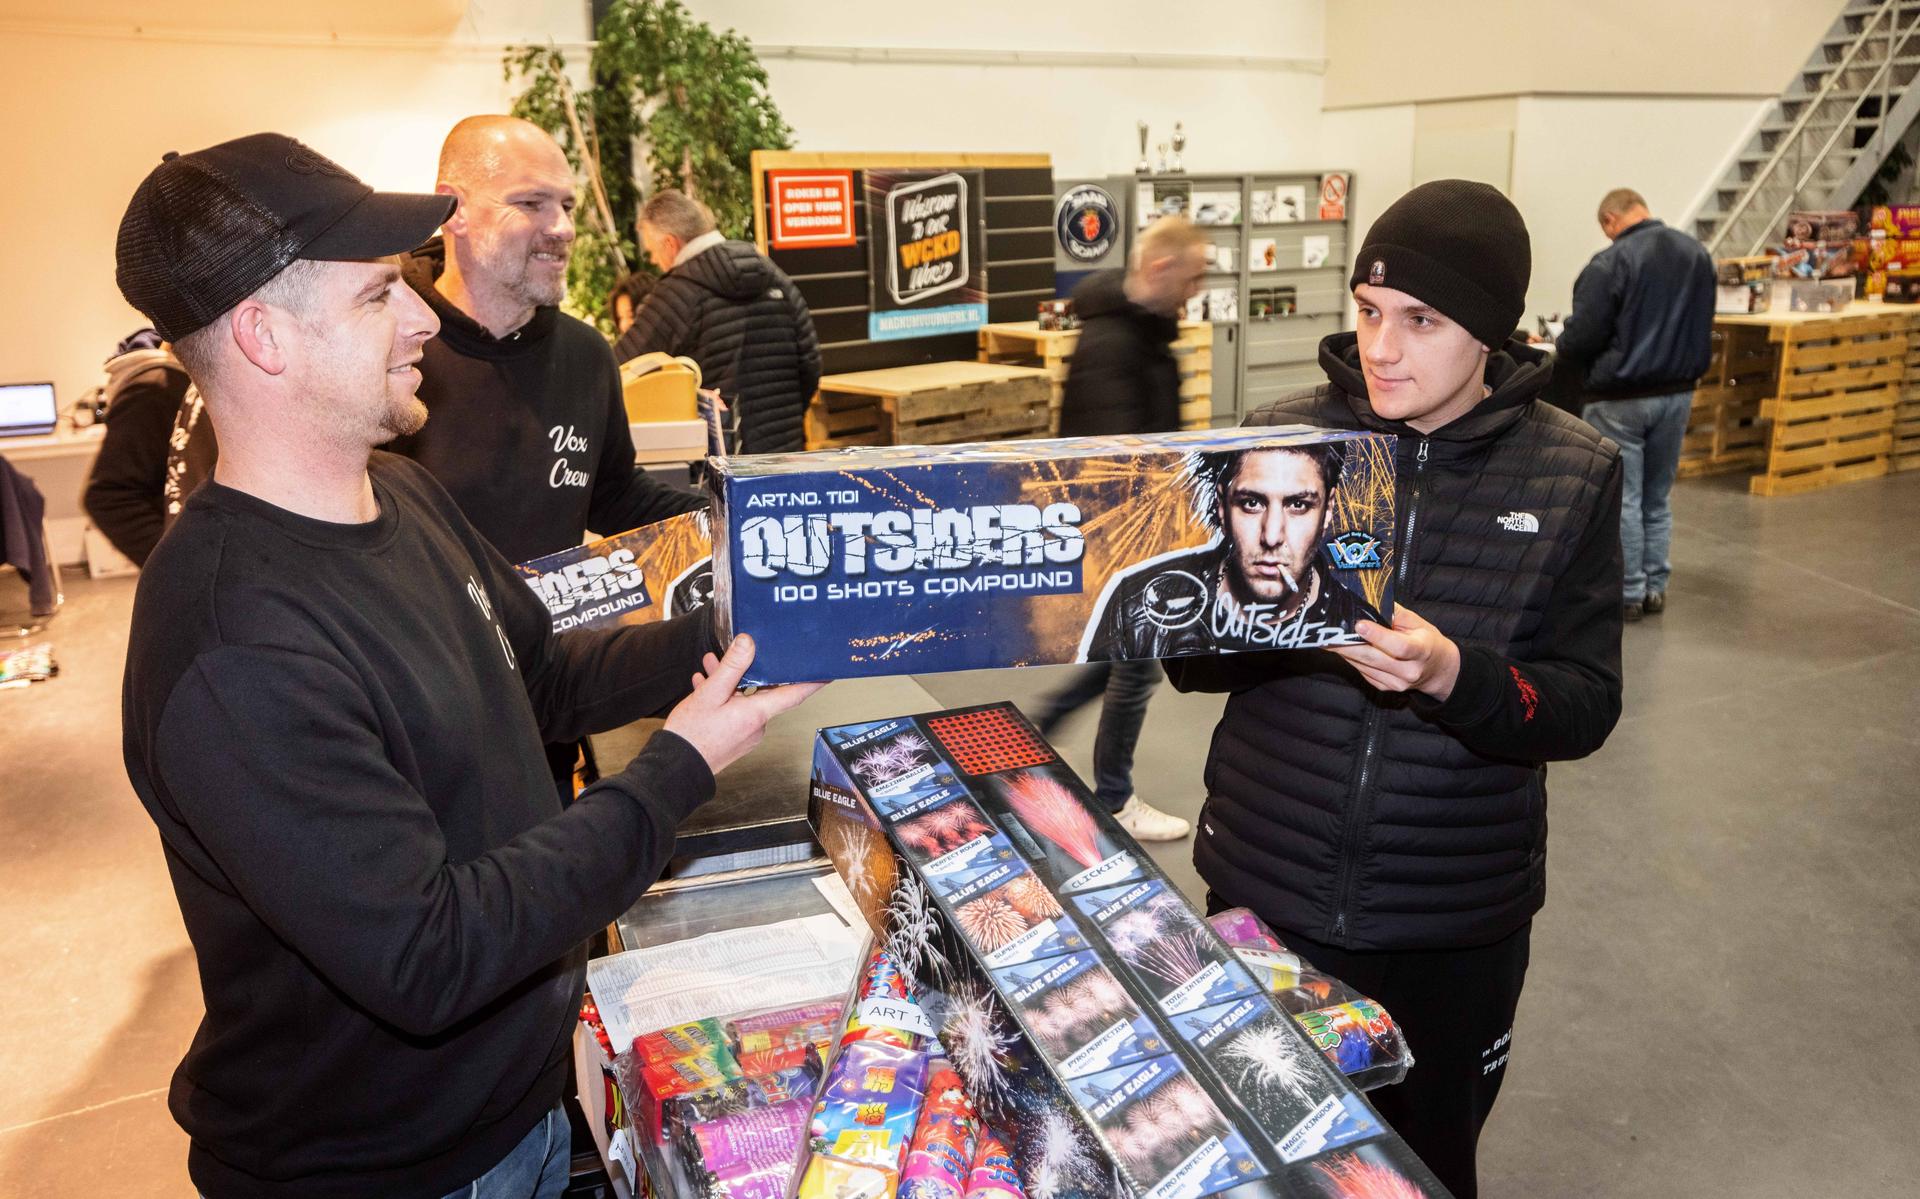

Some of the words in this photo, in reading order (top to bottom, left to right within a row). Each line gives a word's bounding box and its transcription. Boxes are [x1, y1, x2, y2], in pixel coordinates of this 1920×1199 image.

[783, 202, 813, 213] OPEN
[815, 201, 842, 212] VUUR
[785, 188, 822, 199] ROKEN
[785, 216, 842, 227] VERBODEN
[900, 230, 960, 270] WCKD
[549, 425, 588, 453] Vox
[550, 458, 589, 488] Crew
[1497, 515, 1525, 526] NORTH
[1503, 523, 1525, 532] FACE
[1509, 511, 1526, 520] THE
[740, 502, 1085, 578] OUTSIDERS
[1327, 541, 1381, 565] VOX
[774, 584, 817, 603] 100
[827, 579, 915, 600] SHOTS
[924, 570, 1073, 595] COMPOUND
[840, 736, 867, 750] BLUE
[867, 721, 898, 739] EAGLE
[905, 765, 928, 779] BALLET
[813, 787, 832, 801] BLUE
[832, 793, 857, 809] EAGLE
[890, 803, 918, 822] BLUE
[918, 789, 950, 809] EAGLE
[930, 850, 960, 869] PERFECT
[959, 840, 982, 856] ROUND
[947, 884, 977, 904] BLUE
[976, 865, 1010, 888] EAGLE
[1071, 855, 1126, 889] CLICKITY
[1096, 901, 1124, 922] BLUE
[1122, 883, 1151, 907] EAGLE
[994, 943, 1016, 959] SUPER
[1014, 979, 1045, 1003] BLUE
[1044, 956, 1080, 983] EAGLE
[1165, 990, 1186, 1009] TOTAL
[1185, 964, 1220, 994] INTENSITY
[869, 1006, 908, 1022] ART
[1198, 1021, 1227, 1047] BLUE
[1224, 999, 1255, 1026] EAGLE
[1067, 1050, 1087, 1069] PYRO
[1086, 1022, 1128, 1055] PERFECTION
[1093, 1091, 1127, 1119] BLUE
[1124, 1062, 1162, 1094] EAGLE
[1281, 1130, 1306, 1153] MAGIC
[1303, 1101, 1336, 1132] KINGDOM
[1156, 1177, 1178, 1198] PYRO
[1176, 1140, 1219, 1180] PERFECTION
